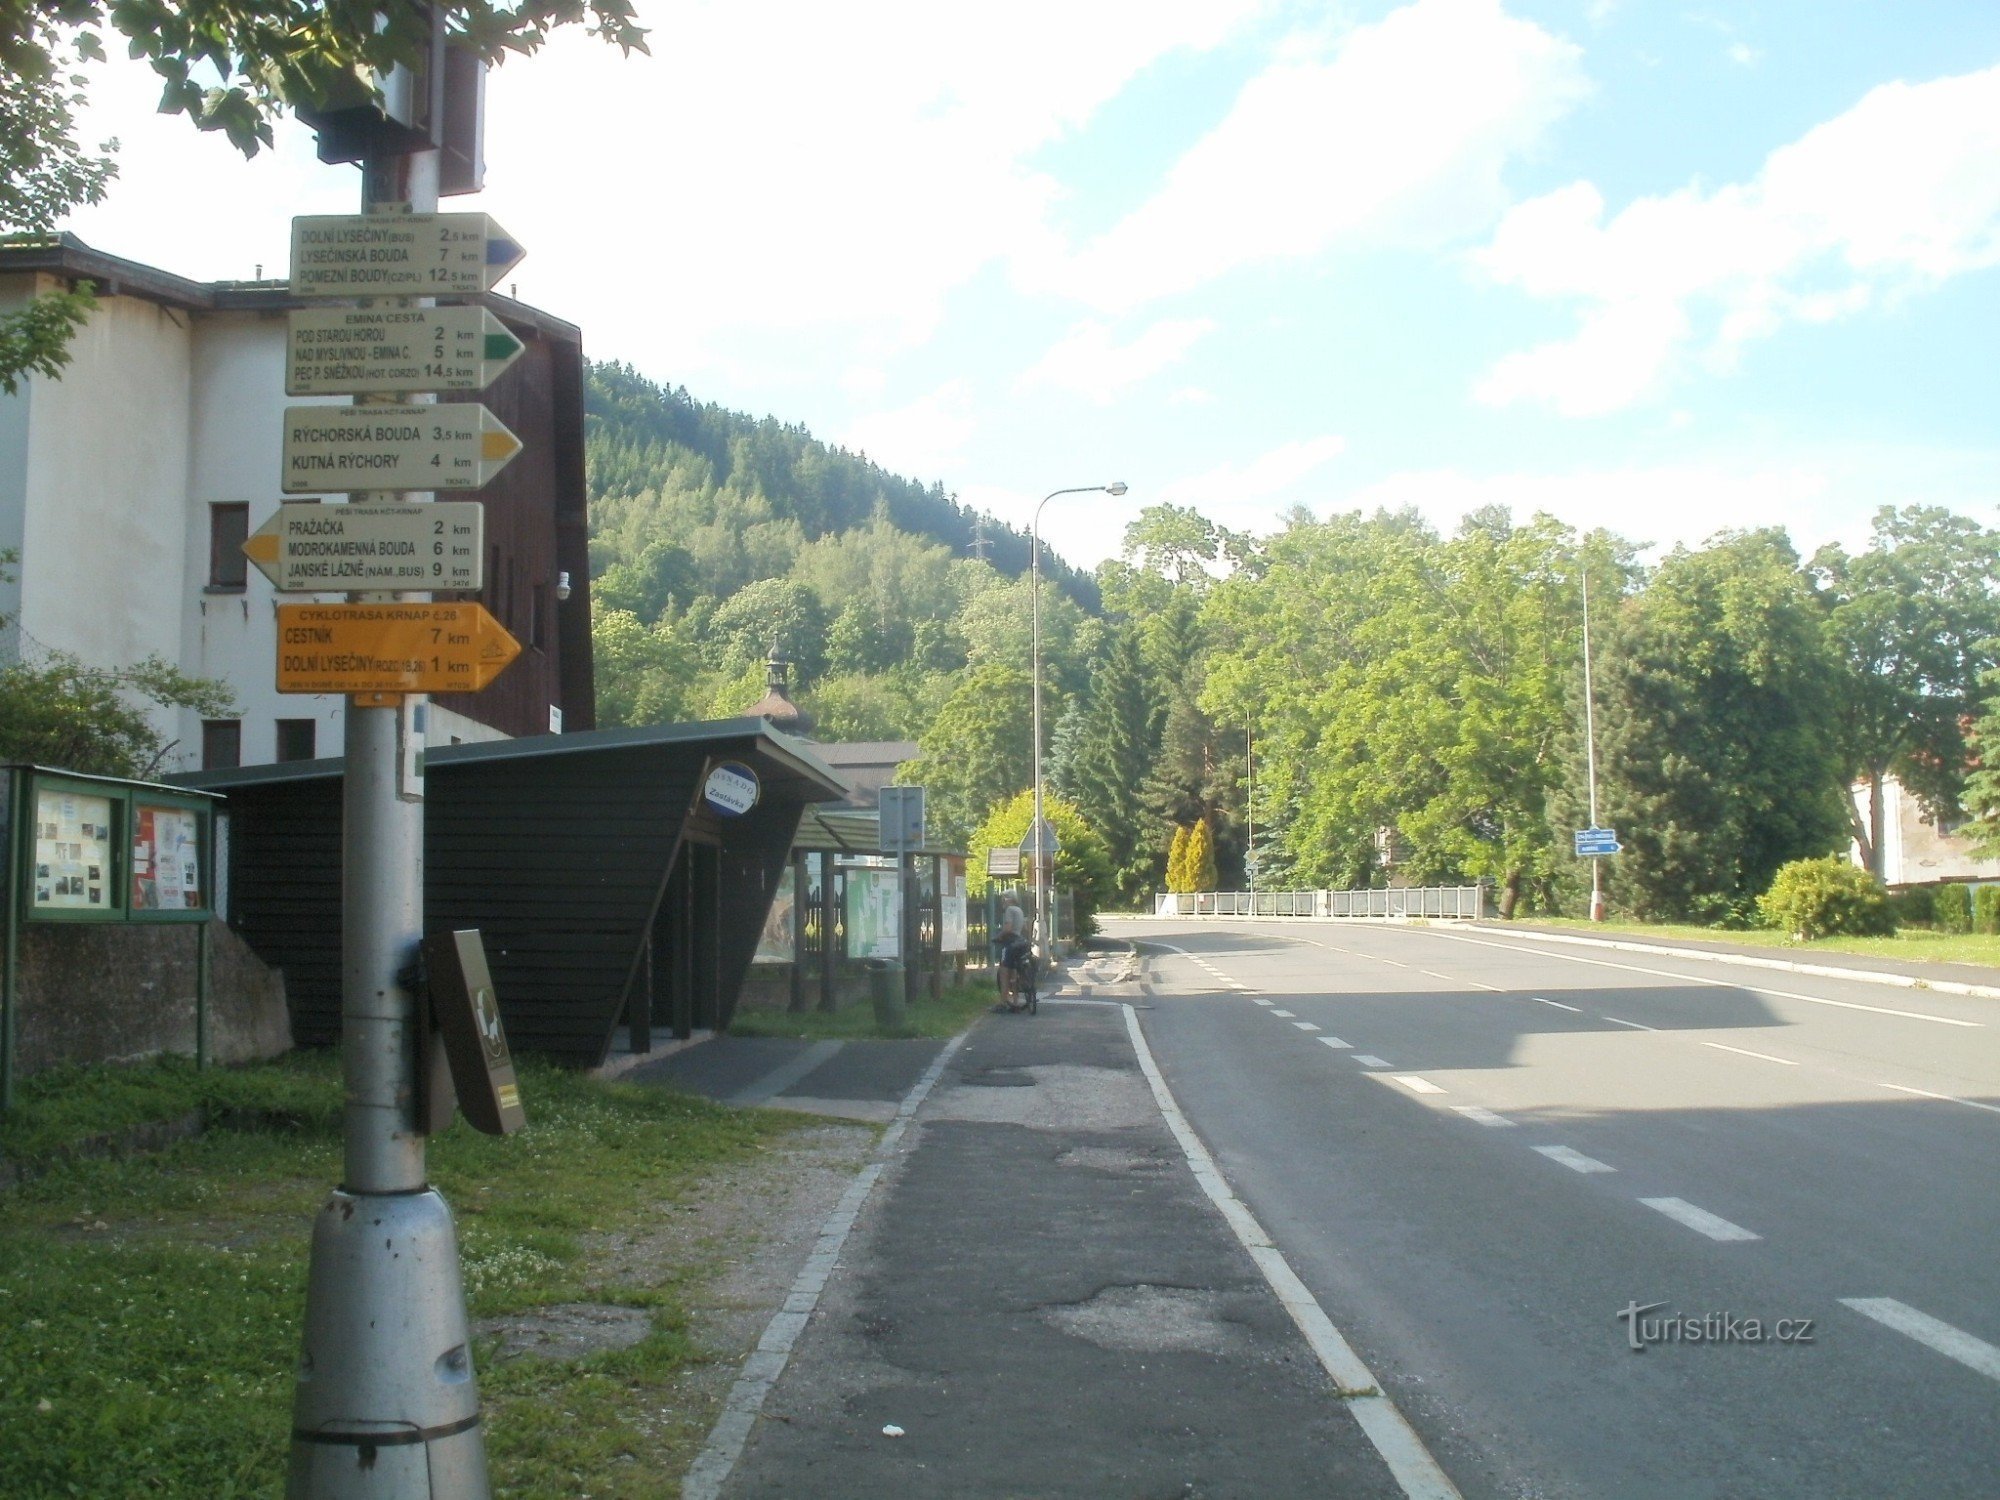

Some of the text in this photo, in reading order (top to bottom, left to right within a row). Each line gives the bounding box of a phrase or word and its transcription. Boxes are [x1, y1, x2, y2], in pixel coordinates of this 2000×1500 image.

[301, 229, 334, 244] DOLNÍ
[462, 232, 479, 241] km
[301, 248, 408, 263] LYSEČINSKÁ BOUDA
[440, 248, 478, 261] 7 km
[300, 267, 347, 283] POMEZNÍ
[461, 272, 478, 281] km
[346, 313, 425, 324] EMINA CESTA
[297, 328, 385, 343] POD STAROU HOROU
[434, 326, 474, 340] 2 km
[296, 348, 313, 361] NAD
[316, 347, 366, 360] MYSLIVNOU
[434, 345, 473, 359] 5 km
[295, 367, 312, 380] PEC
[456, 367, 473, 376] km
[293, 425, 420, 442] RÝCHORSKÁ BOUDA
[455, 431, 472, 440] km
[292, 453, 399, 469] KUTNÁ RÝCHORY
[431, 453, 471, 467] 4 km
[354, 508, 379, 516] TRASA
[289, 519, 471, 535] PRAŽAČKA 2 km
[288, 539, 470, 556] MODROKAMENNÁ BOUDA 6 km
[288, 560, 329, 578] JANSKÉ
[331, 559, 364, 577] LÁZNĚ
[432, 562, 442, 576] 9
[452, 567, 470, 576] km
[300, 610, 383, 621] CYKLOTRASA
[386, 610, 430, 620] KRNAP
[285, 625, 470, 645] CESTNÍK 7 km
[284, 652, 319, 672] DOLNÍ
[431, 656, 440, 672] 1
[447, 661, 470, 673] km
